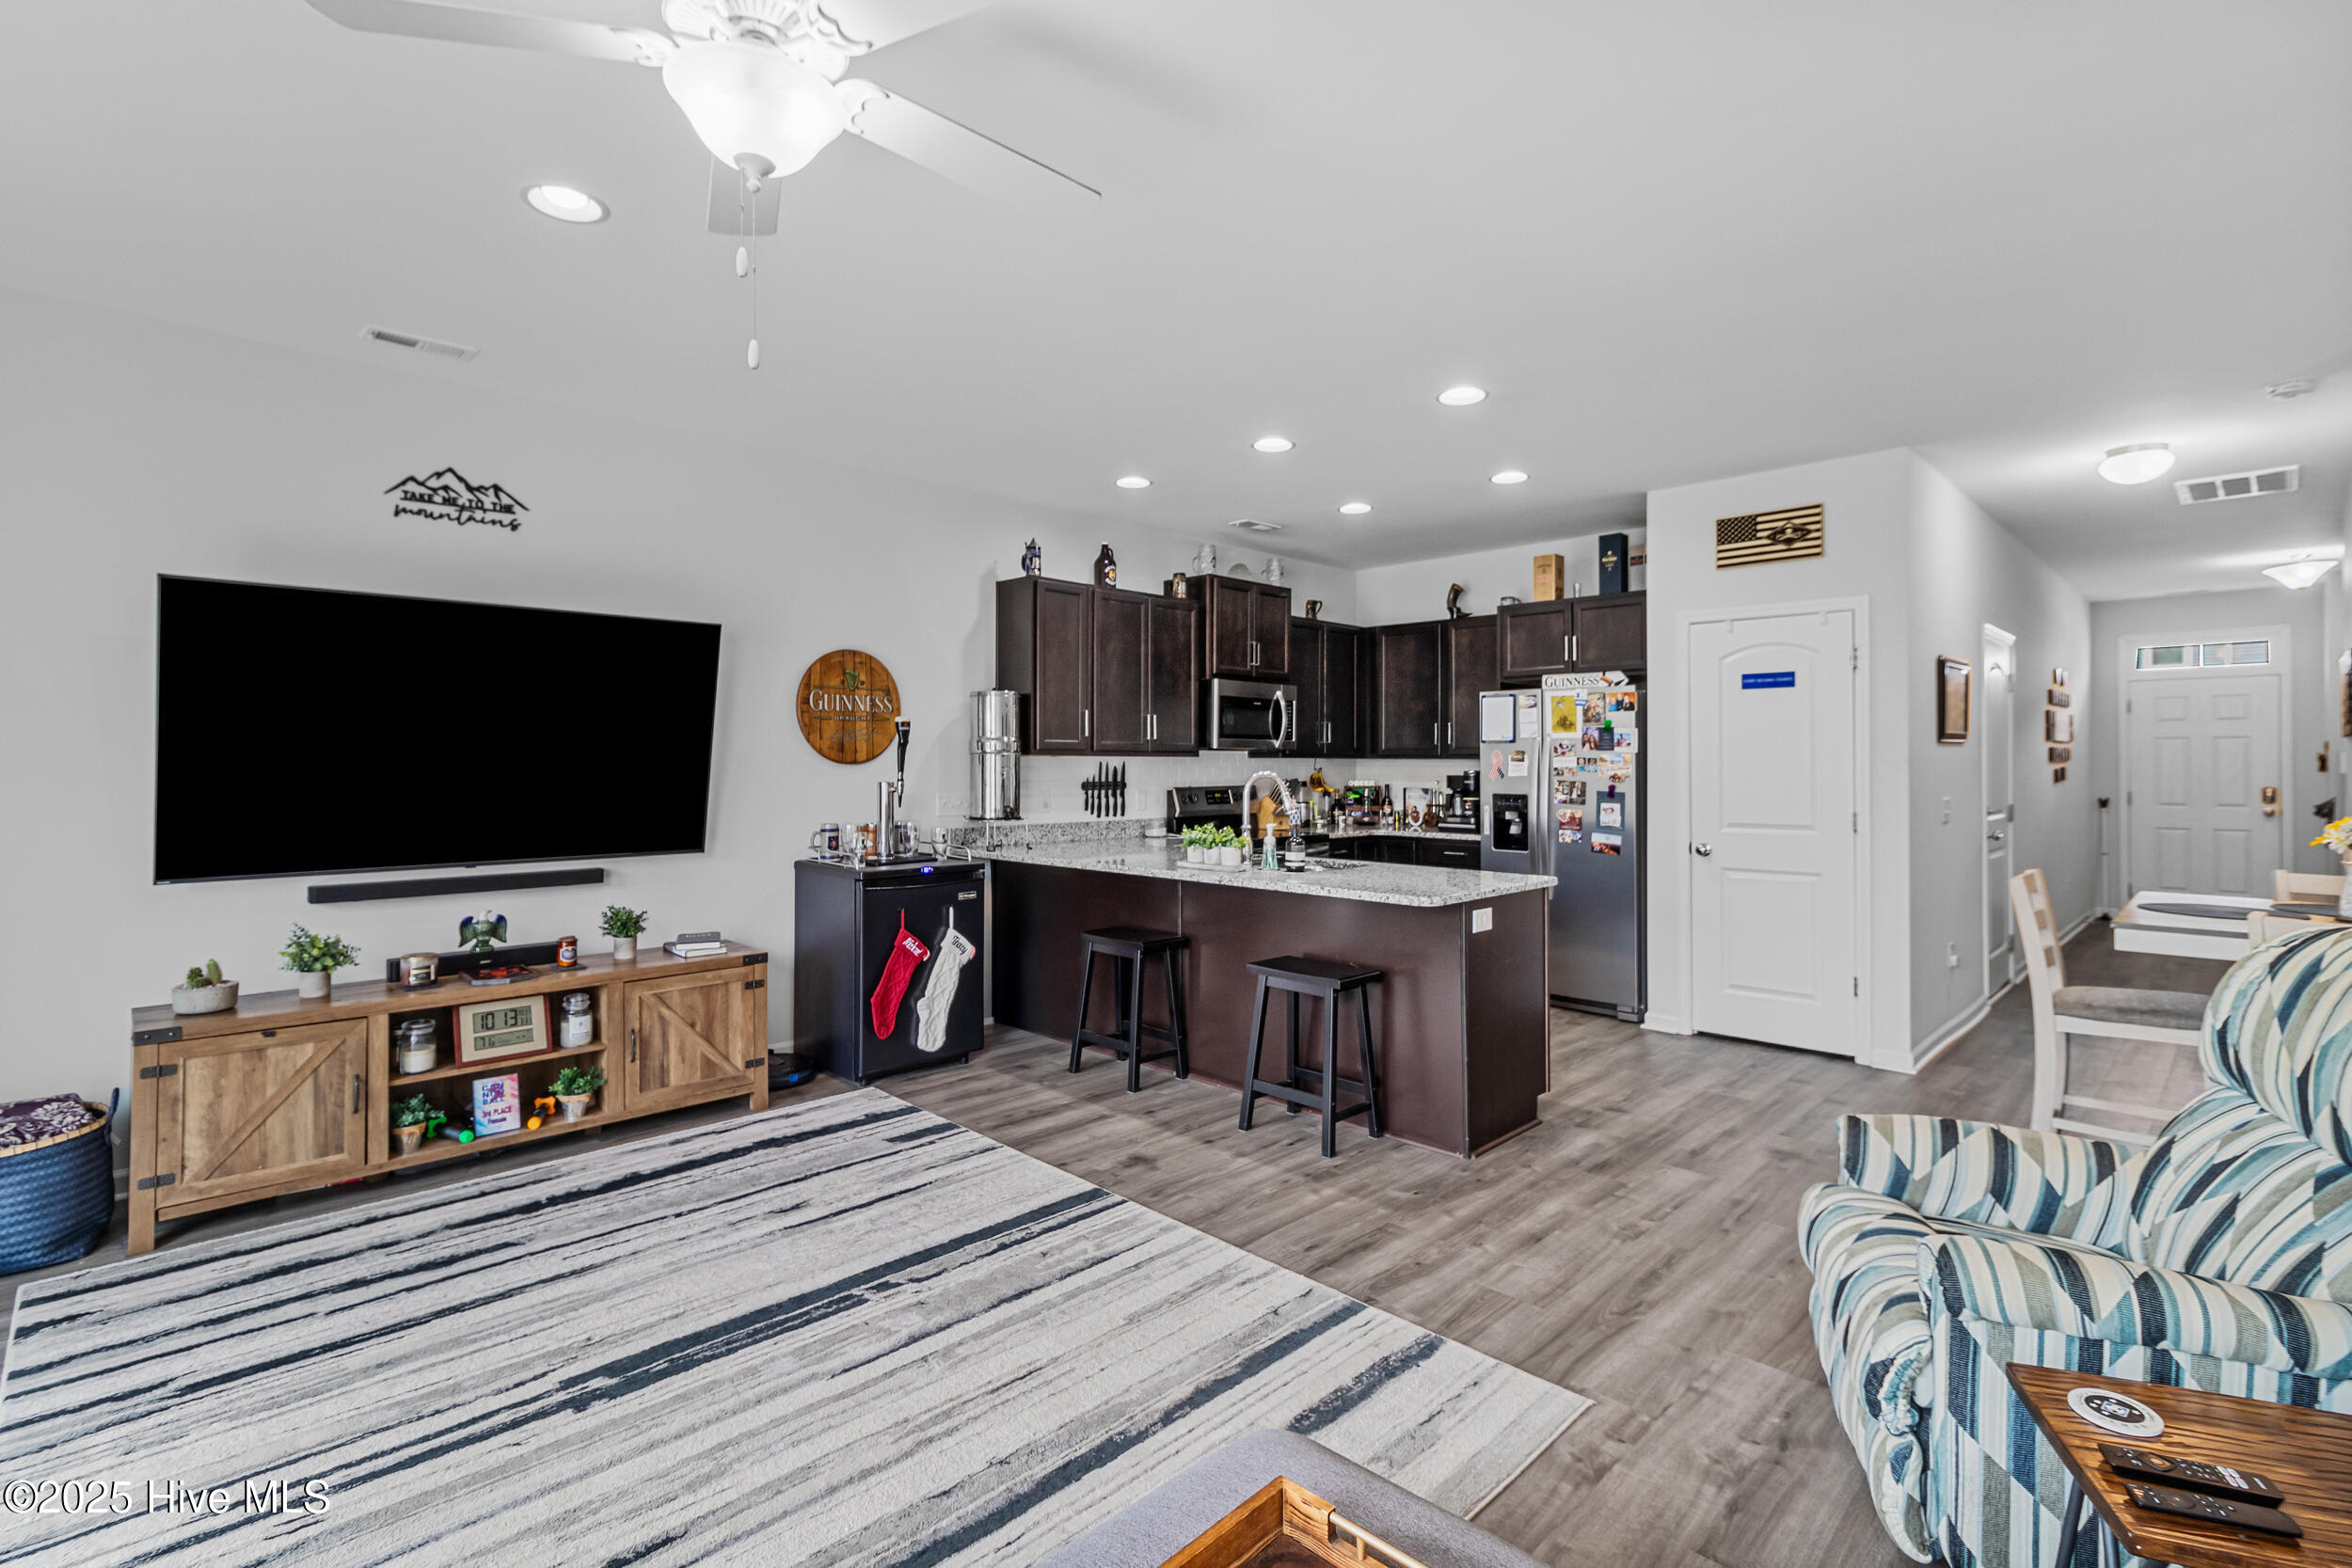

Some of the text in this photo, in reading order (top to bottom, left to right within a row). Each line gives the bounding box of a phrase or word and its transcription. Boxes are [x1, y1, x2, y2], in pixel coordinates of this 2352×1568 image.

[401, 489, 516, 514] TAKE ME TO THE
[393, 502, 522, 532] mountains
[1544, 675, 1599, 688] GUINNESS
[809, 689, 893, 714] GUINNESS
[951, 935, 968, 956] Tracy
[483, 1097, 505, 1105] BALL
[493, 1105, 512, 1116] PLACE
